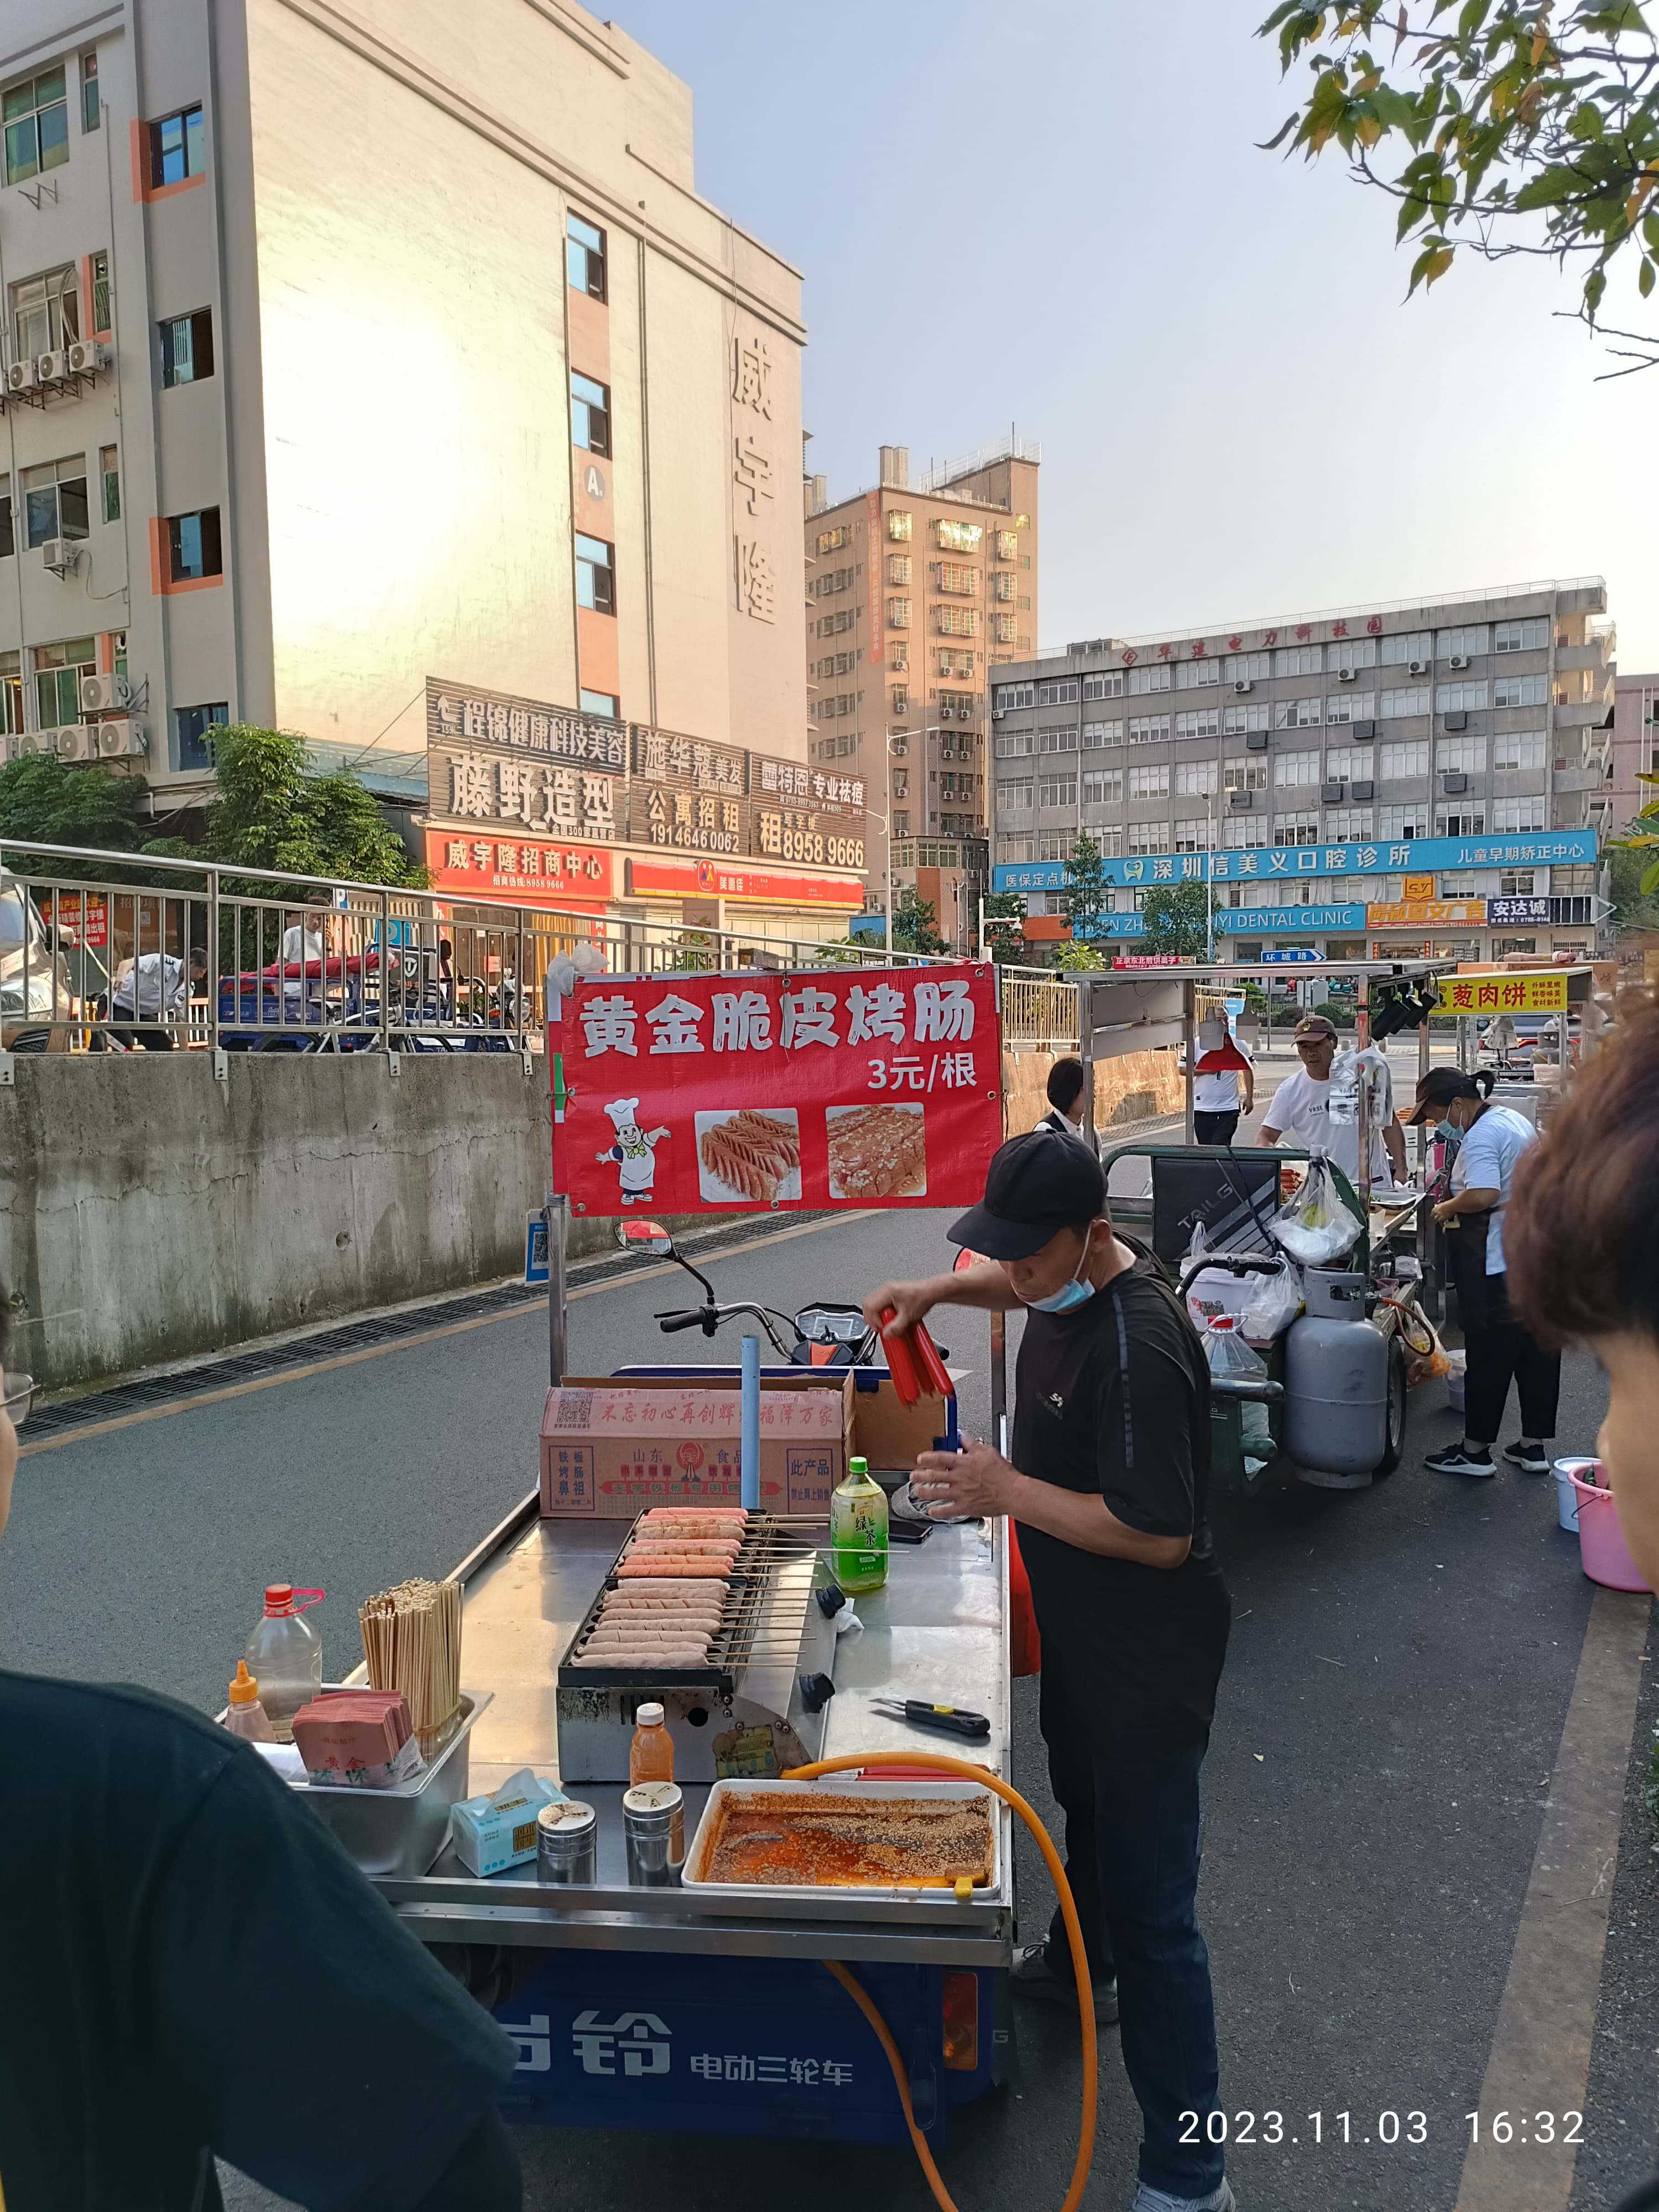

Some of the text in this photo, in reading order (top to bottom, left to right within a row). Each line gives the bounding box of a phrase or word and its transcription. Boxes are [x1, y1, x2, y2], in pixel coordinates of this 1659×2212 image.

[463, 699, 623, 764] 程锦健康科技美容
[450, 754, 615, 828] 藤野造型
[813, 773, 863, 806] 专业祛痘
[649, 790, 739, 832] 公寓招租
[761, 812, 781, 853] 租
[448, 839, 603, 880] 威宇隆招商中心
[784, 831, 863, 867] 8958 9666
[1154, 844, 1412, 880] 深圳信美义口腔诊所
[1458, 843, 1584, 864] 儿童早期矫正中心
[1006, 872, 1080, 888] 医保定点机
[1238, 913, 1297, 927] DENTAL
[1301, 910, 1352, 925] CLINIC
[1493, 899, 1546, 917] 安达诚
[1266, 952, 1307, 962] 环城路
[1453, 982, 1526, 1009] 葱肉饼
[580, 980, 975, 1058] 黄金脆皮烤肠
[868, 1052, 977, 1093] 3元/根
[601, 1402, 833, 1427] 不忘初心再创辉福泽万家
[559, 1451, 583, 1463] 铁板
[634, 1448, 662, 1463] 山东
[791, 1459, 829, 1476] 此产品
[559, 1466, 584, 1478] 烤肠
[612, 1483, 766, 1494] 夫宇铁板专用烤
[855, 1516, 876, 1546] 绿茶
[690, 2053, 854, 2086] 电动三轮车
